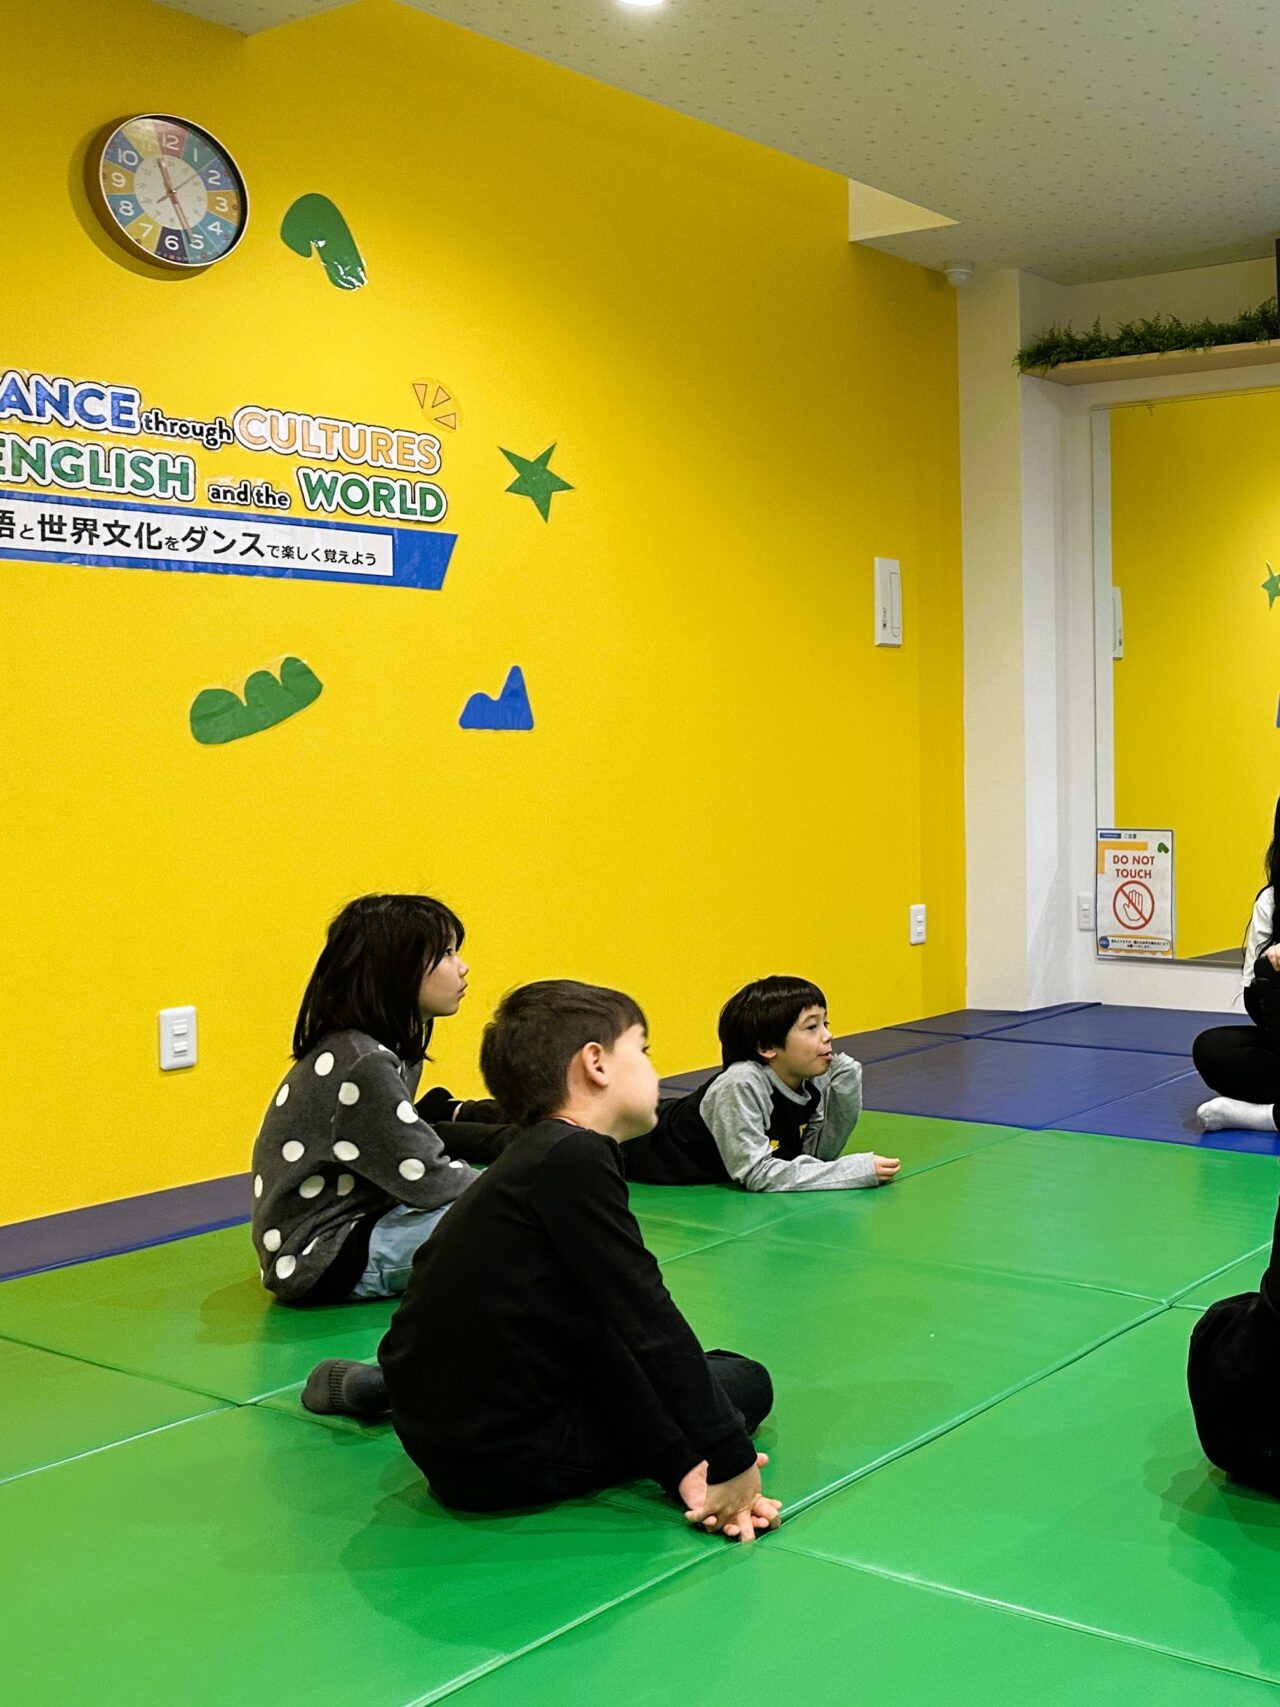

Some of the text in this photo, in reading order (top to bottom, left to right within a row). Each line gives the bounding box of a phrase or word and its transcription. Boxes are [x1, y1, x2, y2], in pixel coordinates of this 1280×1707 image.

[162, 133, 179, 150] 12
[117, 148, 138, 166] 10
[193, 148, 198, 162] 1
[111, 172, 126, 188] 9
[207, 169, 221, 186] 2
[118, 200, 134, 216] 8
[215, 196, 229, 212] 3
[139, 222, 154, 238] 7
[207, 221, 223, 236] 4
[164, 235, 179, 251] 6
[190, 234, 204, 250] 5
[143, 411, 231, 447] through
[239, 411, 437, 470] CULTURES
[211, 484, 248, 503] and
[256, 485, 289, 507] the
[302, 472, 443, 518] WORLD
[1113, 855, 1155, 865] DO NOT
[1115, 868, 1152, 879] TOUCH
